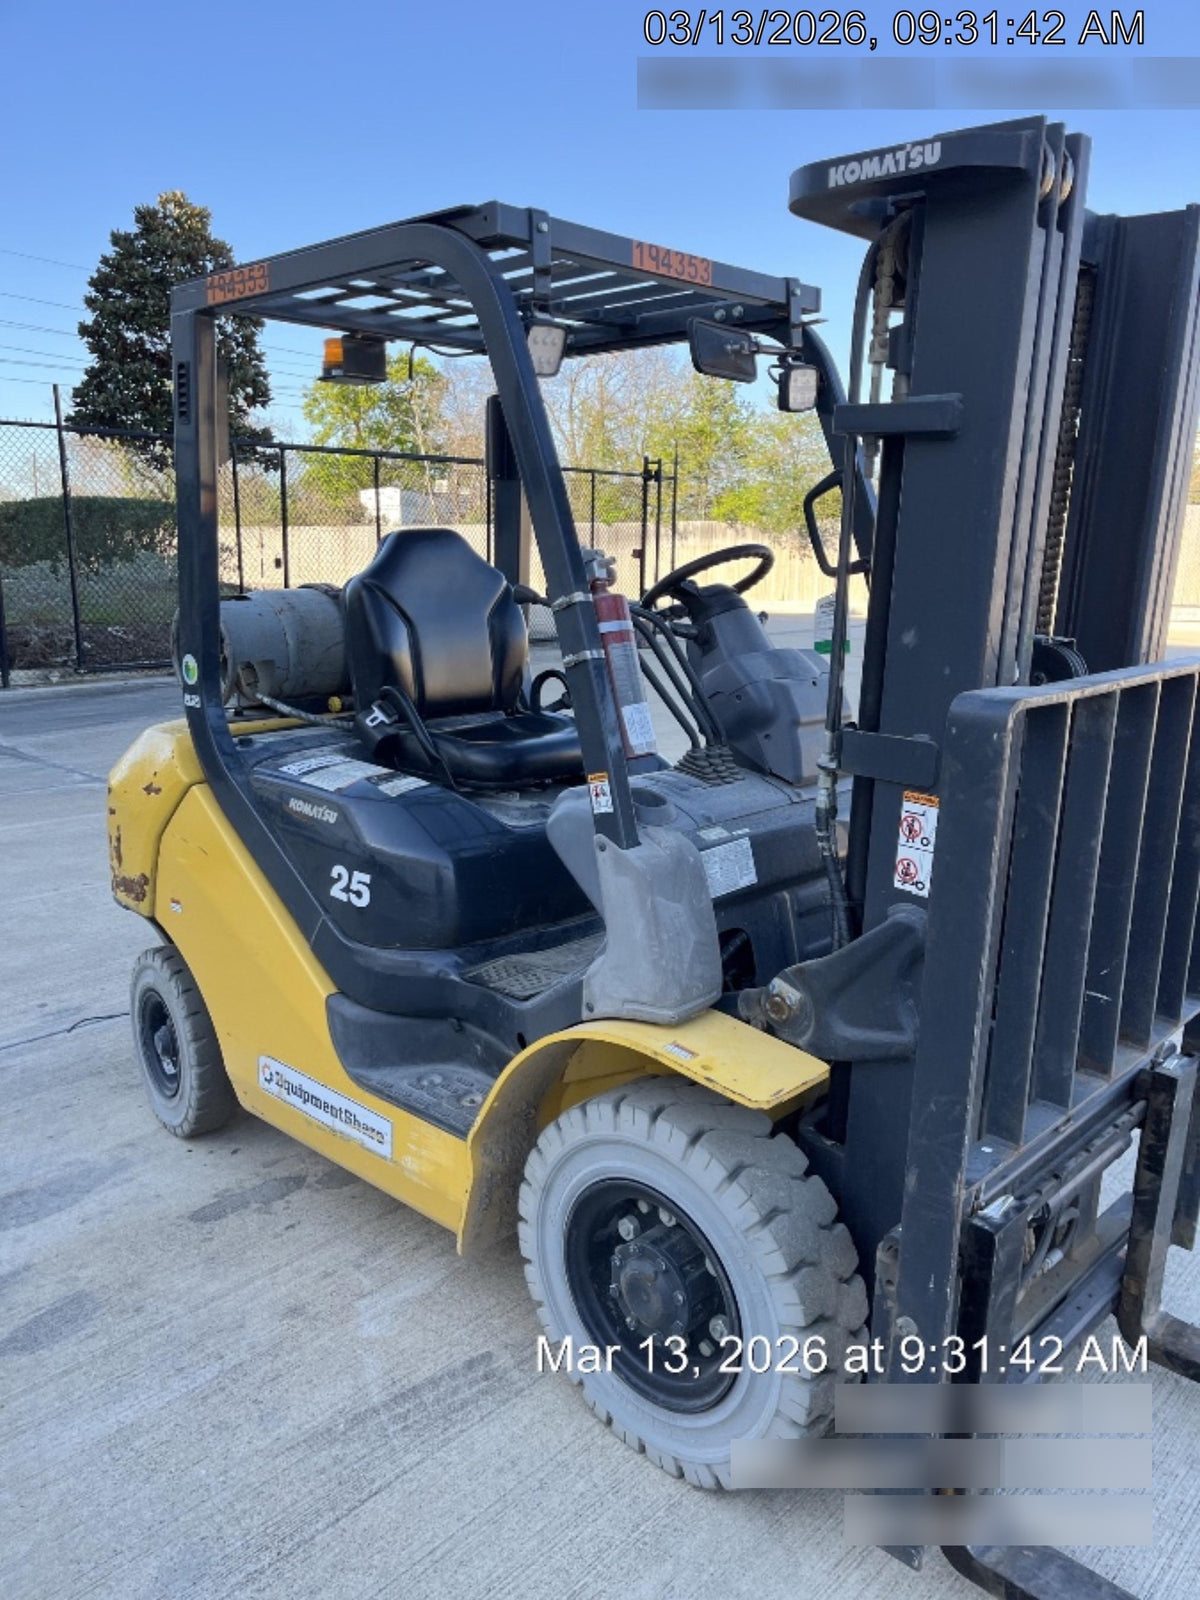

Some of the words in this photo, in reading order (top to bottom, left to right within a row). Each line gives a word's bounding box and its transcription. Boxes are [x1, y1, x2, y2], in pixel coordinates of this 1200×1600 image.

[828, 141, 942, 188] KOMATSU
[636, 241, 710, 284] 194353
[289, 798, 338, 824] KOMATSU
[330, 865, 371, 908] 25
